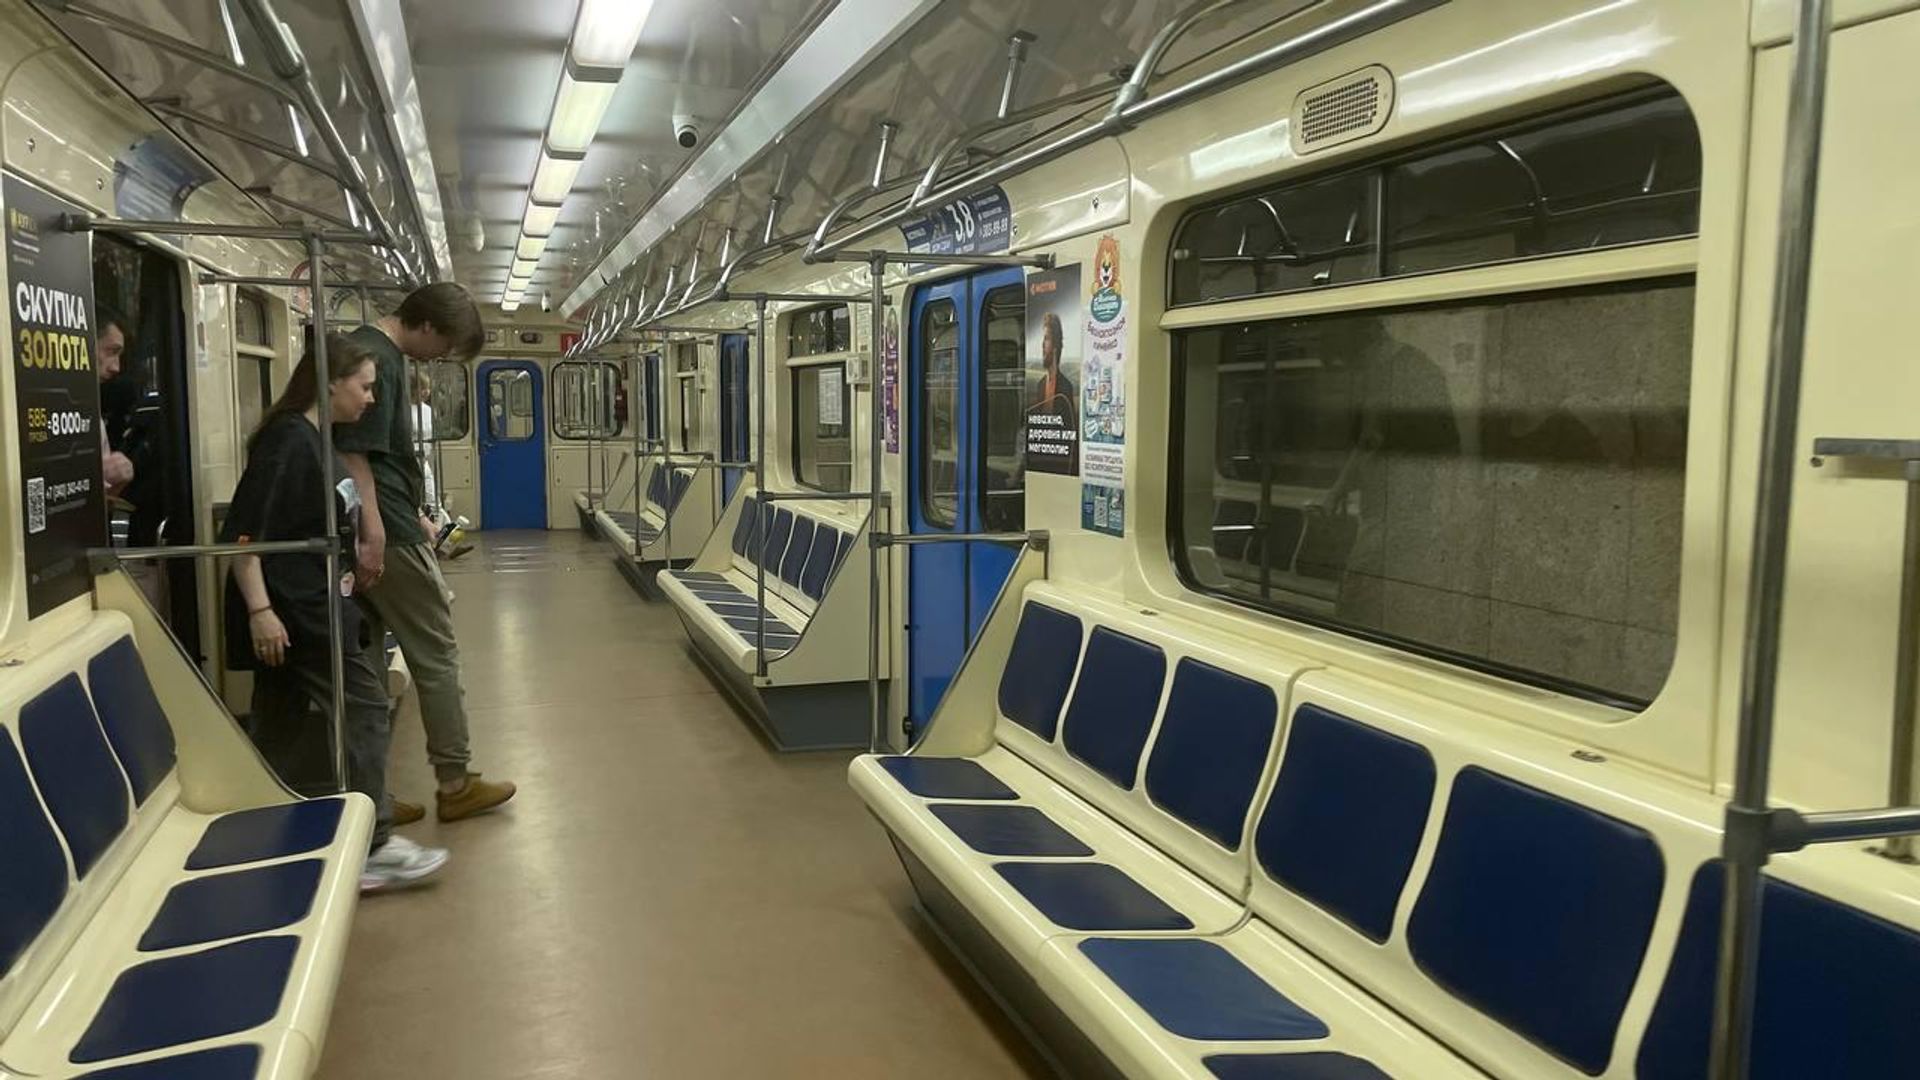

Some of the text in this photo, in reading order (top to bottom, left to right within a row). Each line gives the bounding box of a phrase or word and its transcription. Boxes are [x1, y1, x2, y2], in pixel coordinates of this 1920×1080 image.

[945, 200, 975, 243] 3,8
[16, 281, 88, 331] СКУПКА
[20, 327, 91, 371] ЗОЛОТА
[28, 408, 48, 428] 585
[1028, 415, 1064, 427] неважно,
[1028, 429, 1077, 441] деревня или
[1028, 443, 1069, 456] мегаполис
